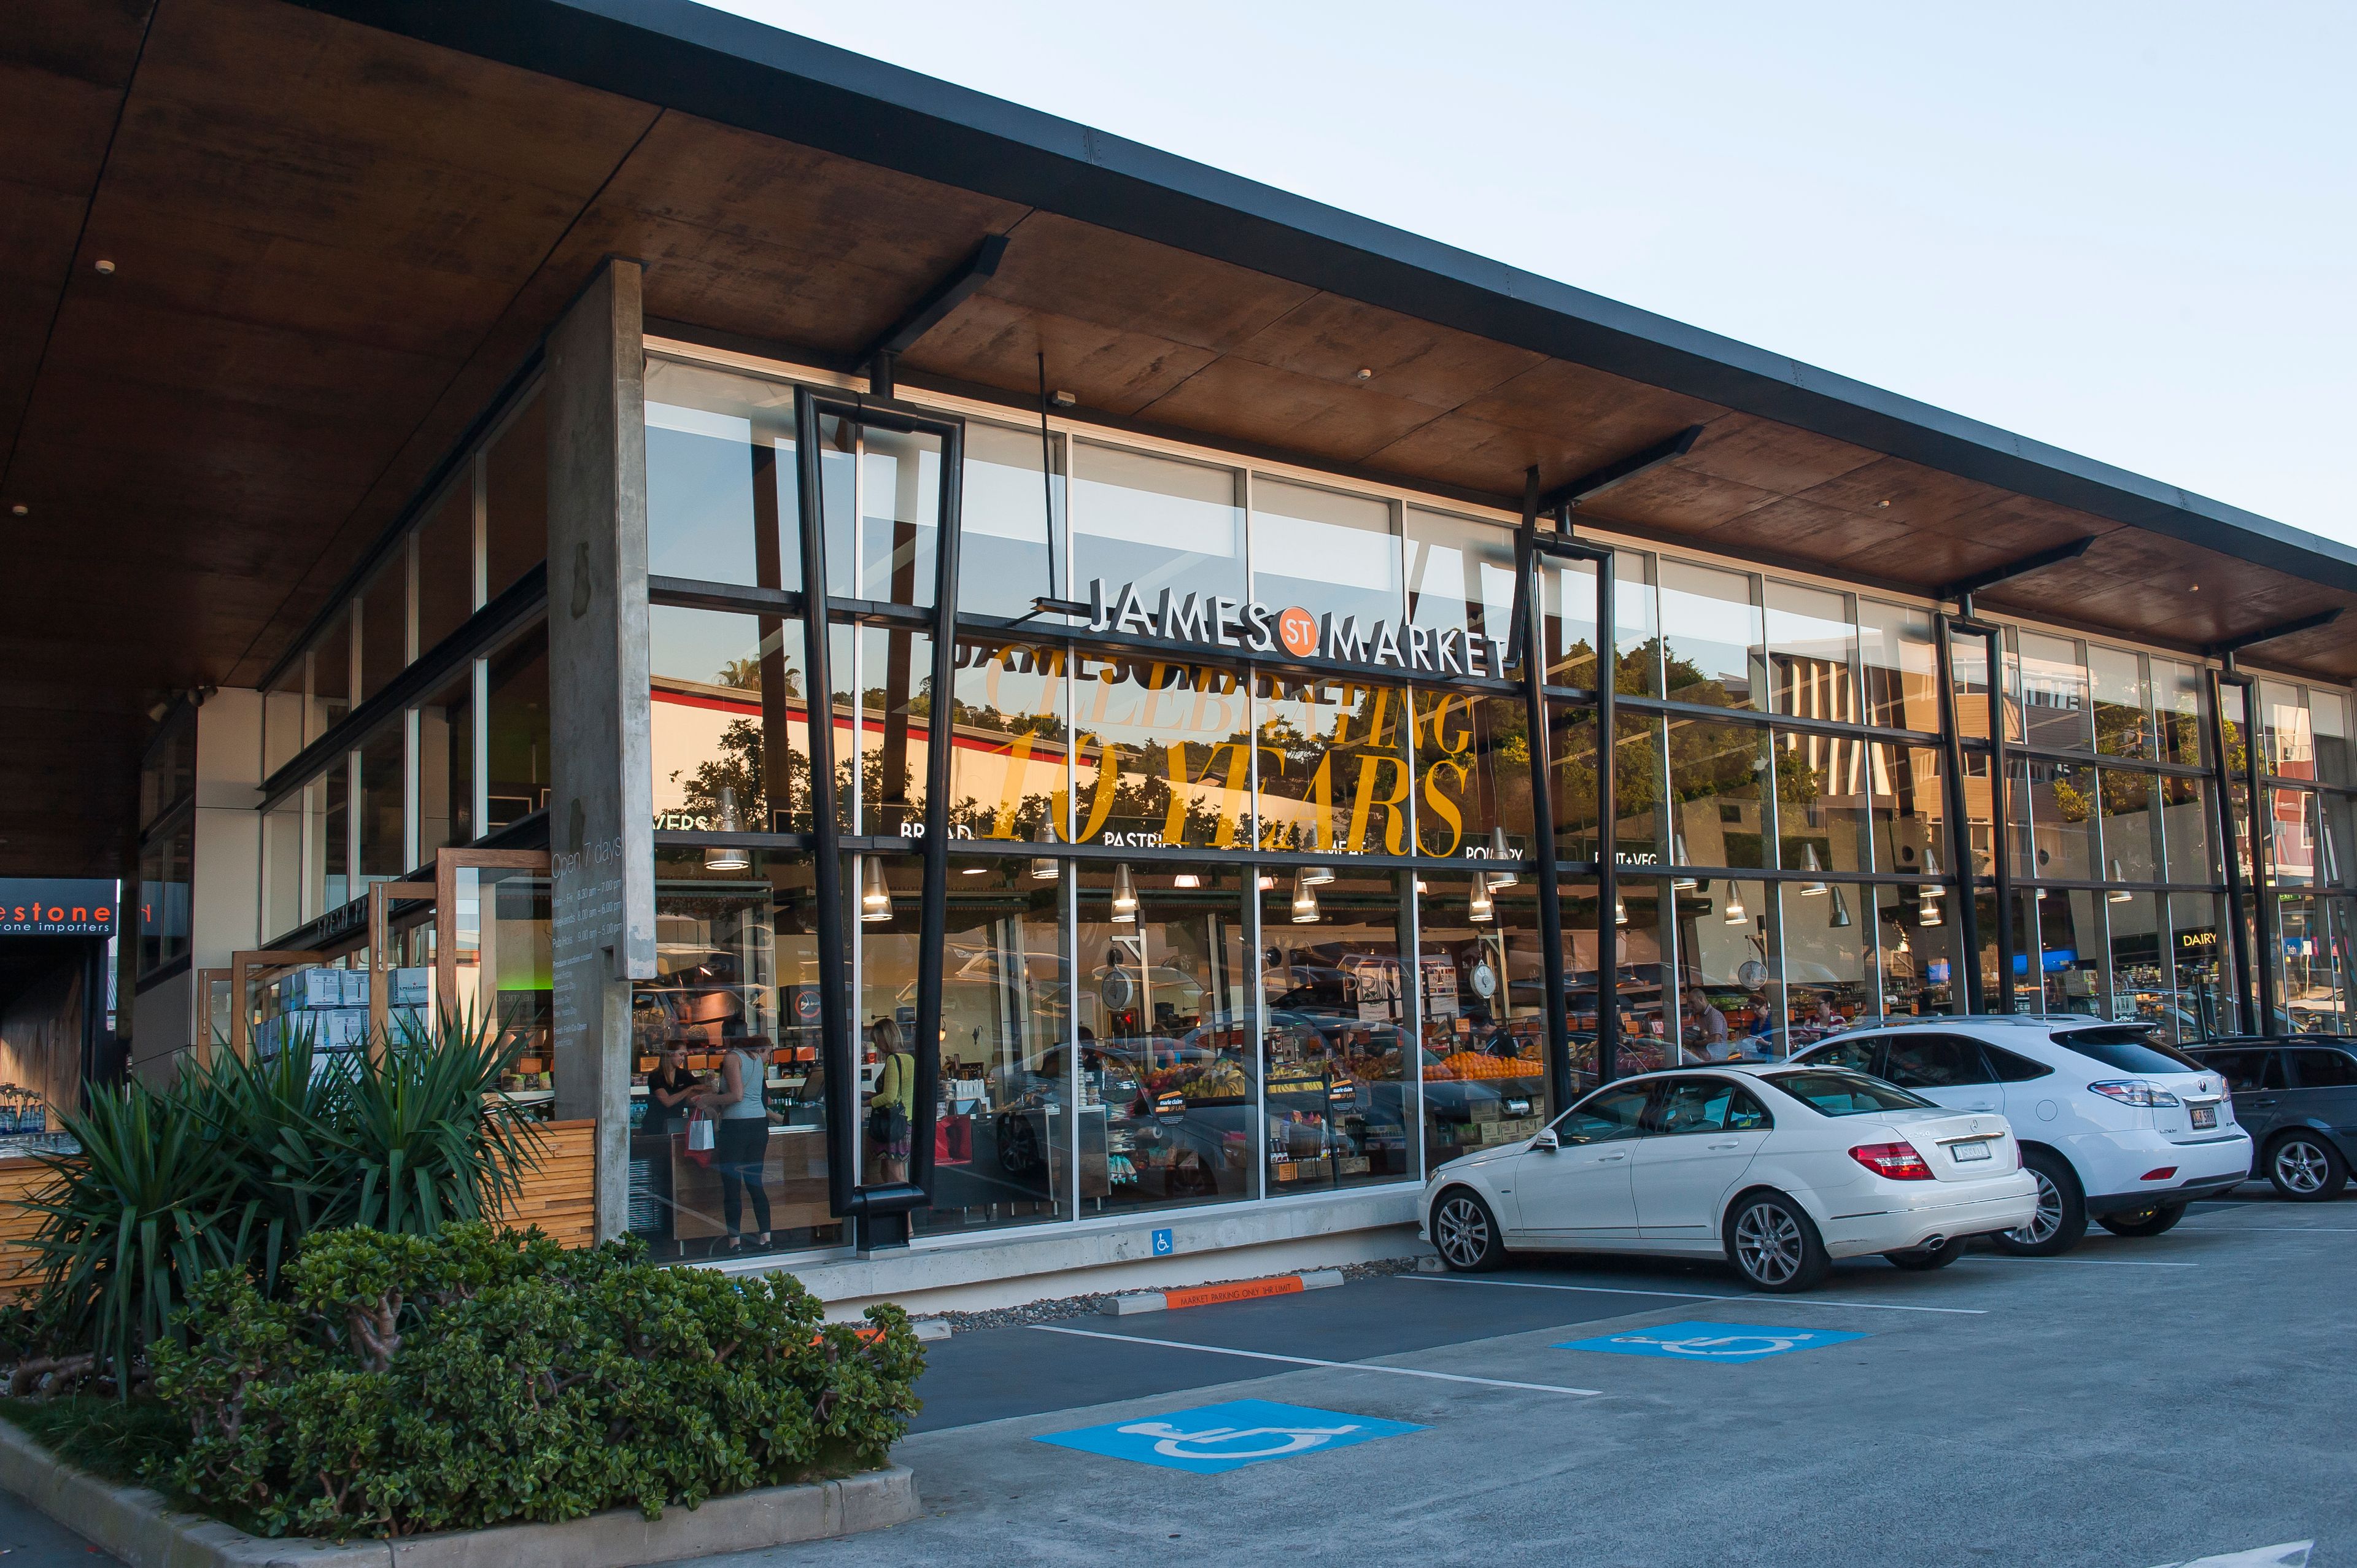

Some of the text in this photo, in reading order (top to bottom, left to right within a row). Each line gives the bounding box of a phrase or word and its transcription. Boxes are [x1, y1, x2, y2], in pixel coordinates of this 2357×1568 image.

[1089, 578, 1506, 679] JAMES ST MARKET
[982, 728, 1468, 858] 10 YEARS
[552, 837, 621, 882] Open 7 days
[39, 922, 109, 932] importers
[2183, 933, 2216, 946] DAIRY
[1180, 1295, 1208, 1306] MARKET
[1211, 1290, 1239, 1302] PARKING
[1242, 1288, 1258, 1297] ONLY
[1275, 1284, 1291, 1293] LIMIT
